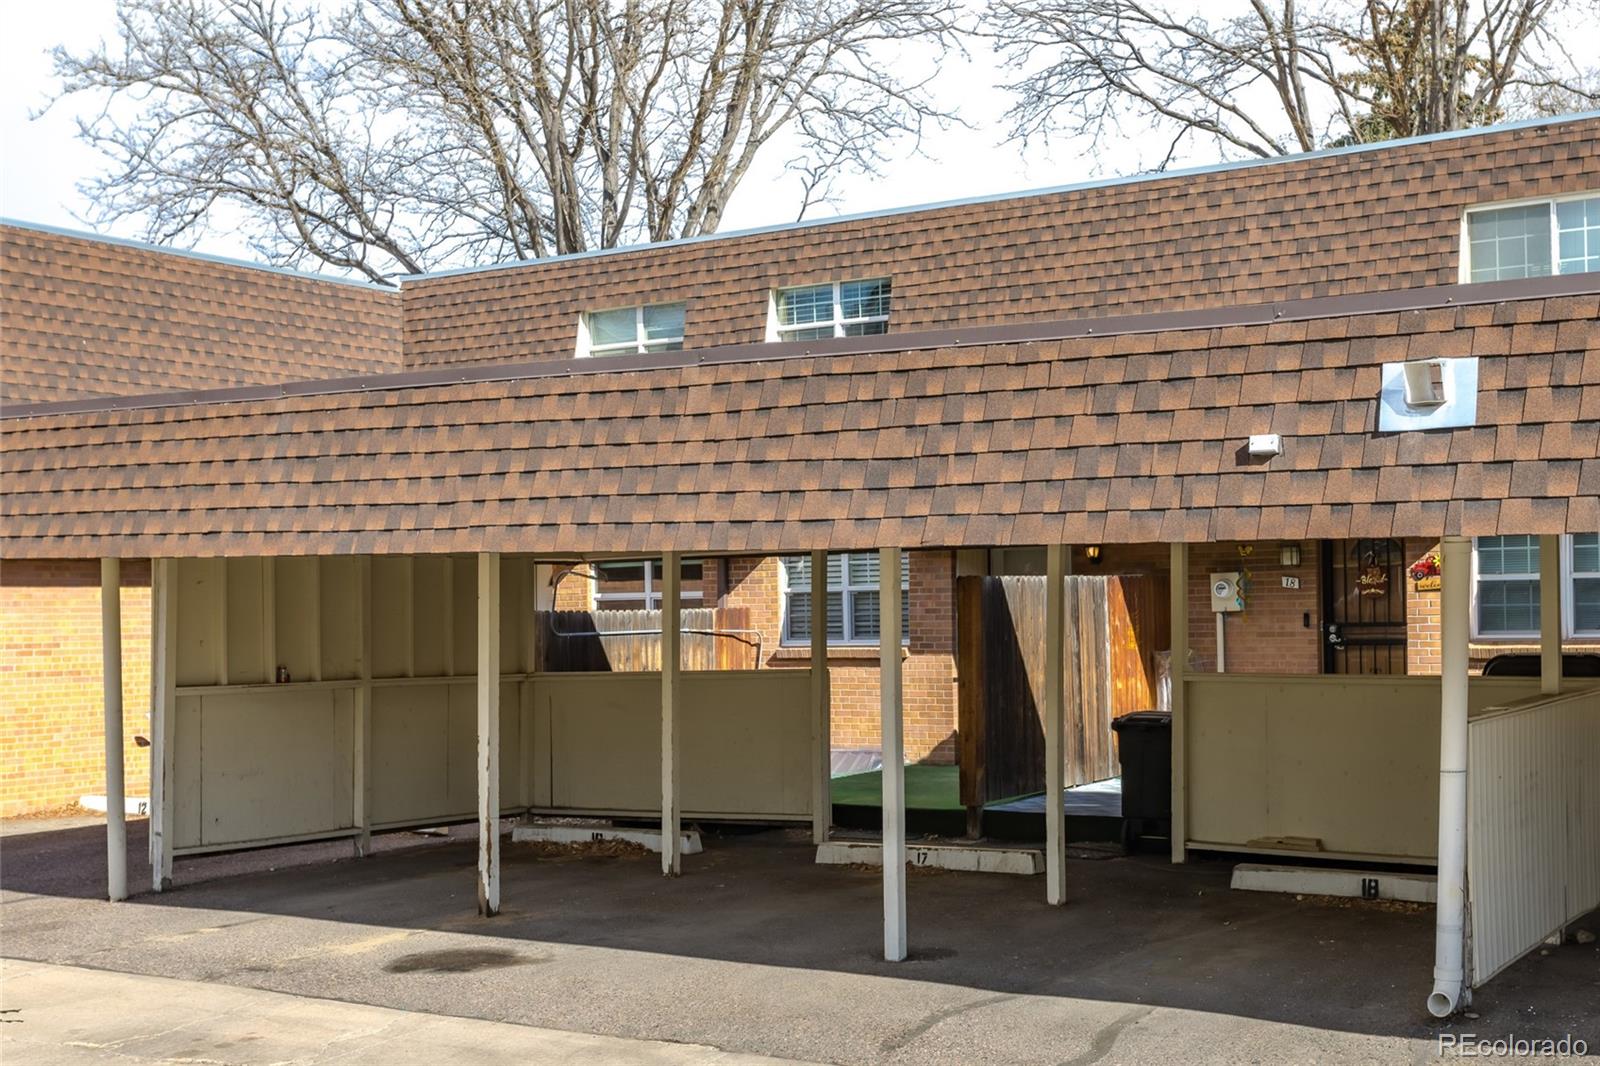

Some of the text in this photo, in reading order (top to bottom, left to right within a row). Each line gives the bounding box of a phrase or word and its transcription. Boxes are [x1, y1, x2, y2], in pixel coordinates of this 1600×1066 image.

[1285, 577, 1296, 588] 18
[137, 801, 148, 815] 12
[917, 852, 928, 865] 17
